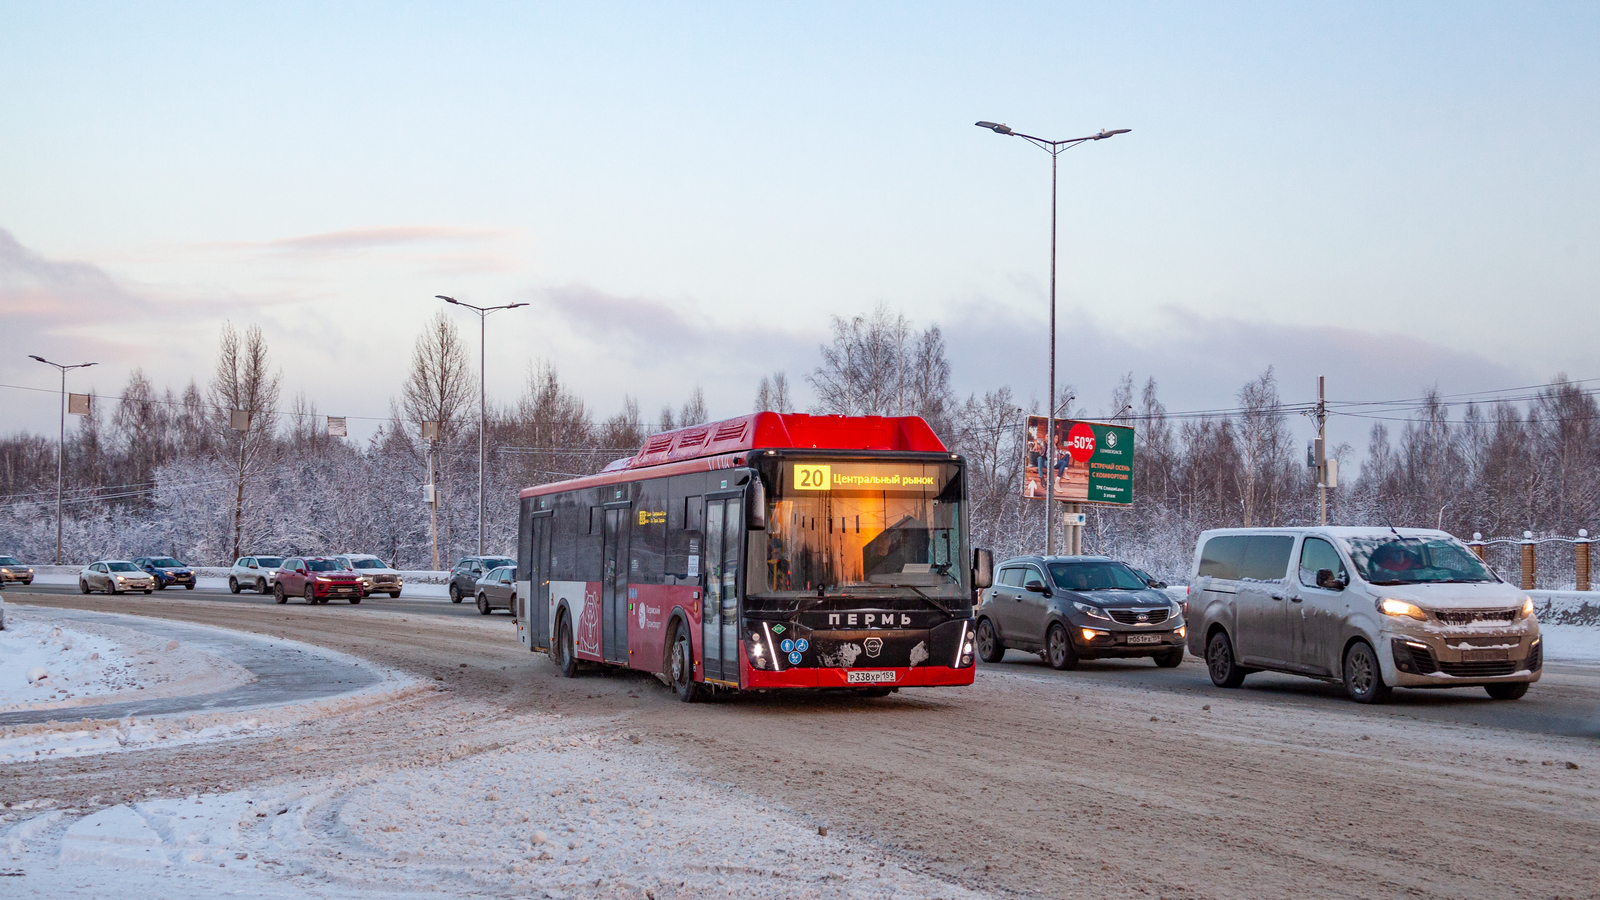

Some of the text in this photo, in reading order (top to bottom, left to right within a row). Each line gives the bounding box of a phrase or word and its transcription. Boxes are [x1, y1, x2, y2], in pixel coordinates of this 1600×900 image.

[1091, 462, 1115, 470] ВСТРЕЧАЙ
[800, 468, 934, 487] 20 Центральный рынок
[828, 613, 912, 626] ПЕРМЬ
[850, 672, 881, 682] Р338ХР
